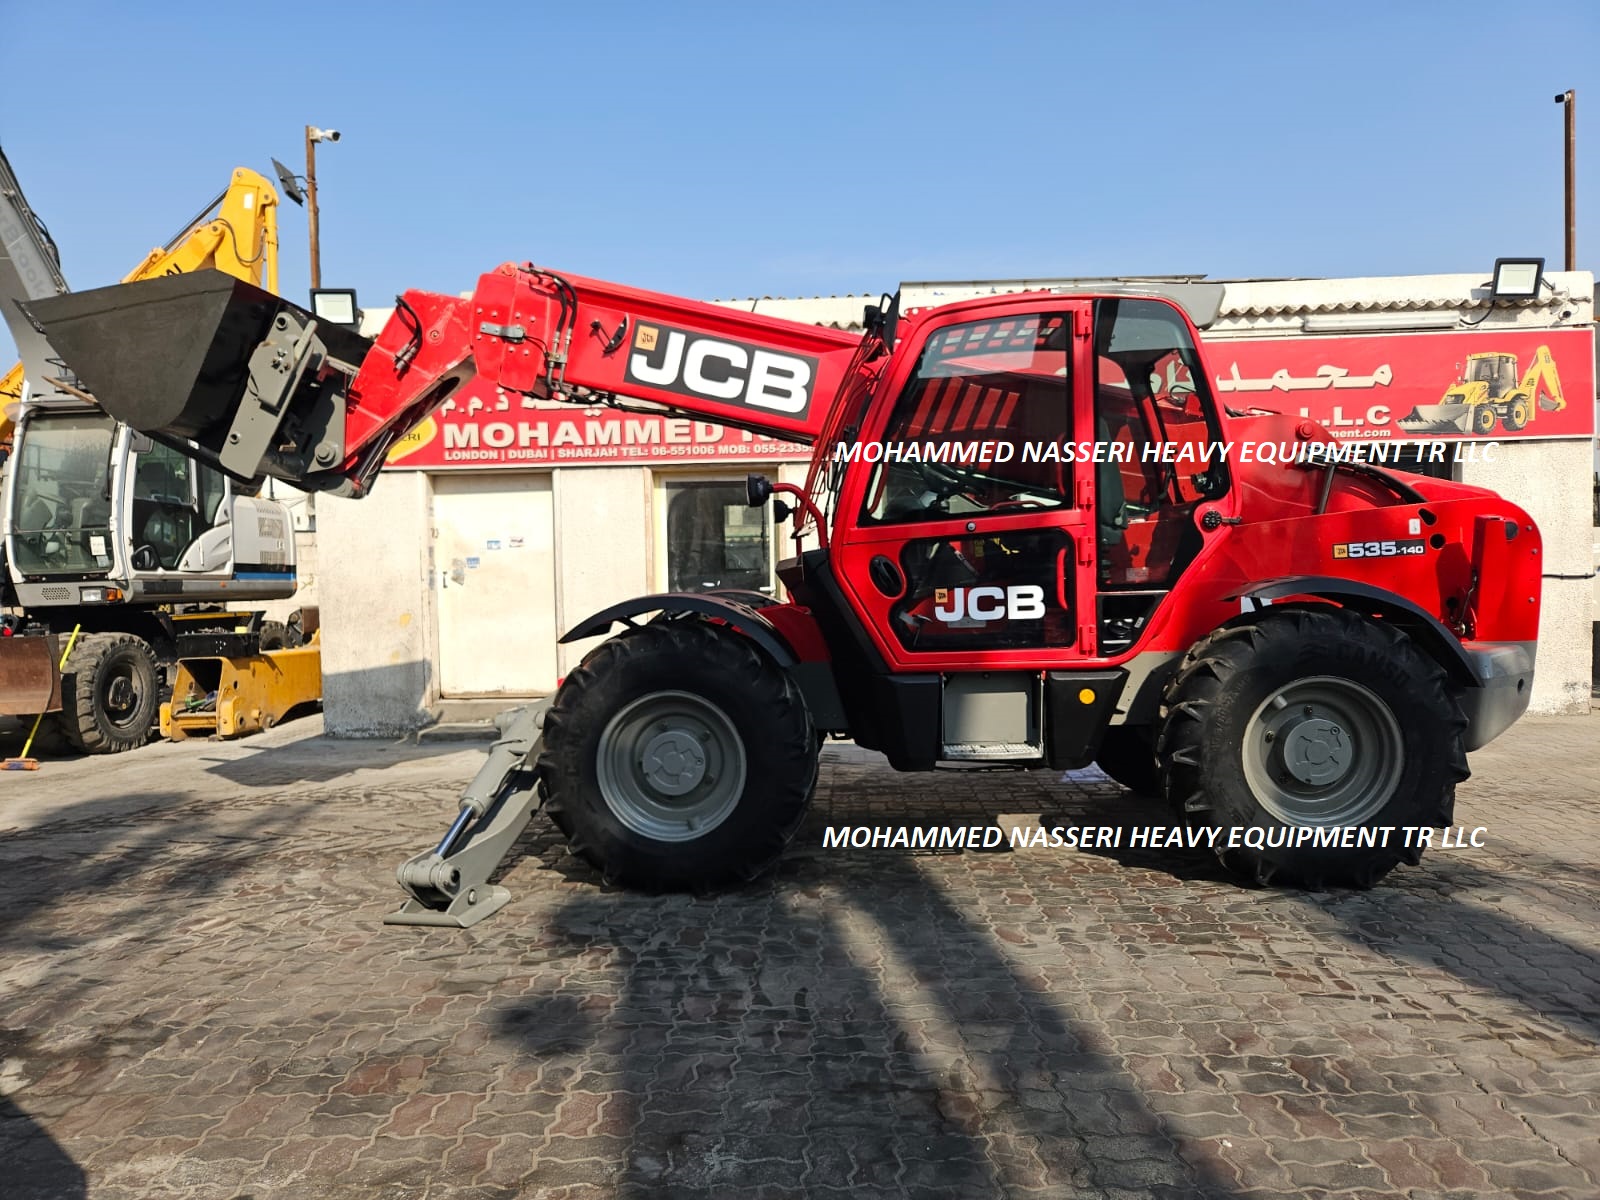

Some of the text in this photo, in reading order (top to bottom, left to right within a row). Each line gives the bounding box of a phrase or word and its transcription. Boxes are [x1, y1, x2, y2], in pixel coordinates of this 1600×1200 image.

[630, 331, 811, 413] JCB
[442, 419, 725, 449] MOHAMMED
[444, 449, 498, 460] LONDON
[508, 449, 547, 459] DUBAI
[558, 447, 618, 458] SHARJAH
[621, 447, 648, 456] TEL:
[718, 444, 750, 455] MOB:
[1348, 541, 1424, 558] 535-140
[934, 585, 1046, 622] JCB
